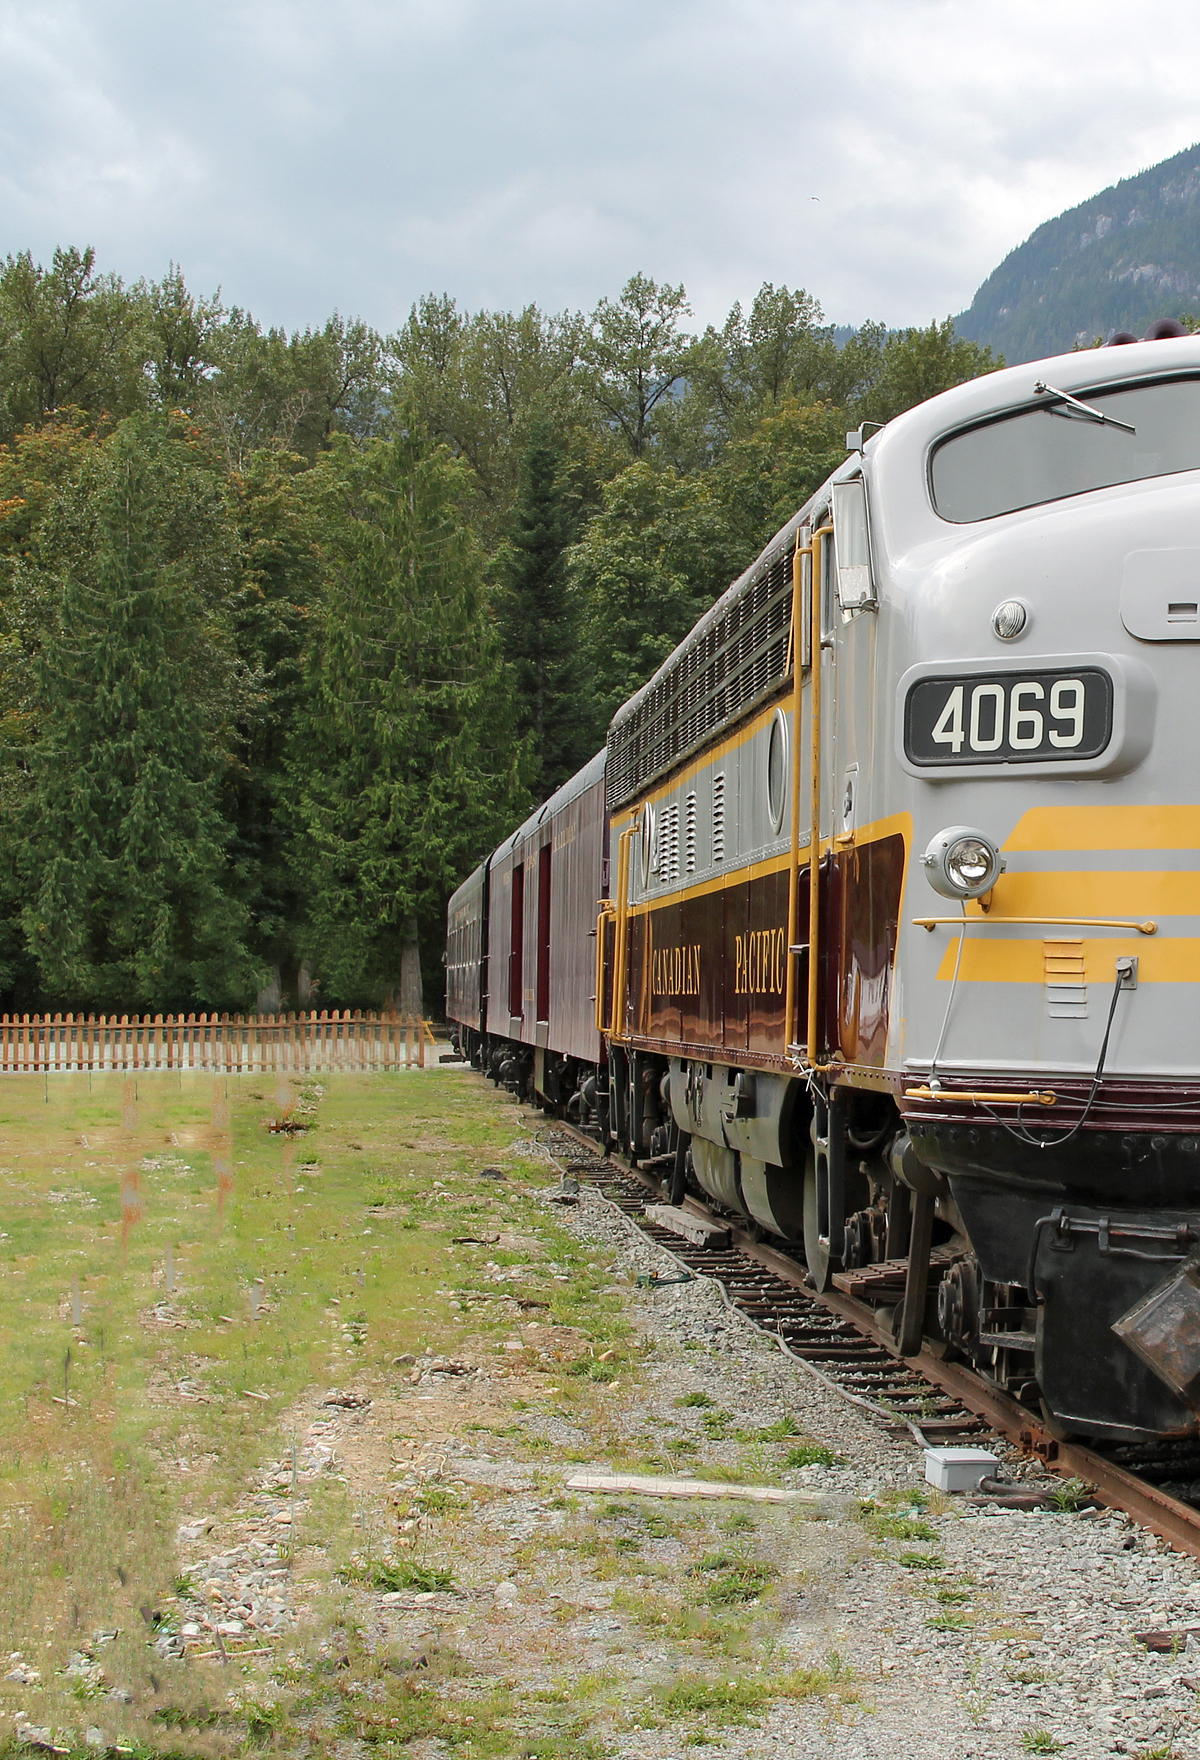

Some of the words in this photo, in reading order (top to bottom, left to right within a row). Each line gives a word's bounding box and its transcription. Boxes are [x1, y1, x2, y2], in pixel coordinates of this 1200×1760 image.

[931, 679, 1085, 753] 4069
[652, 944, 700, 995] CANADIAN
[735, 927, 784, 994] PACIFIC
